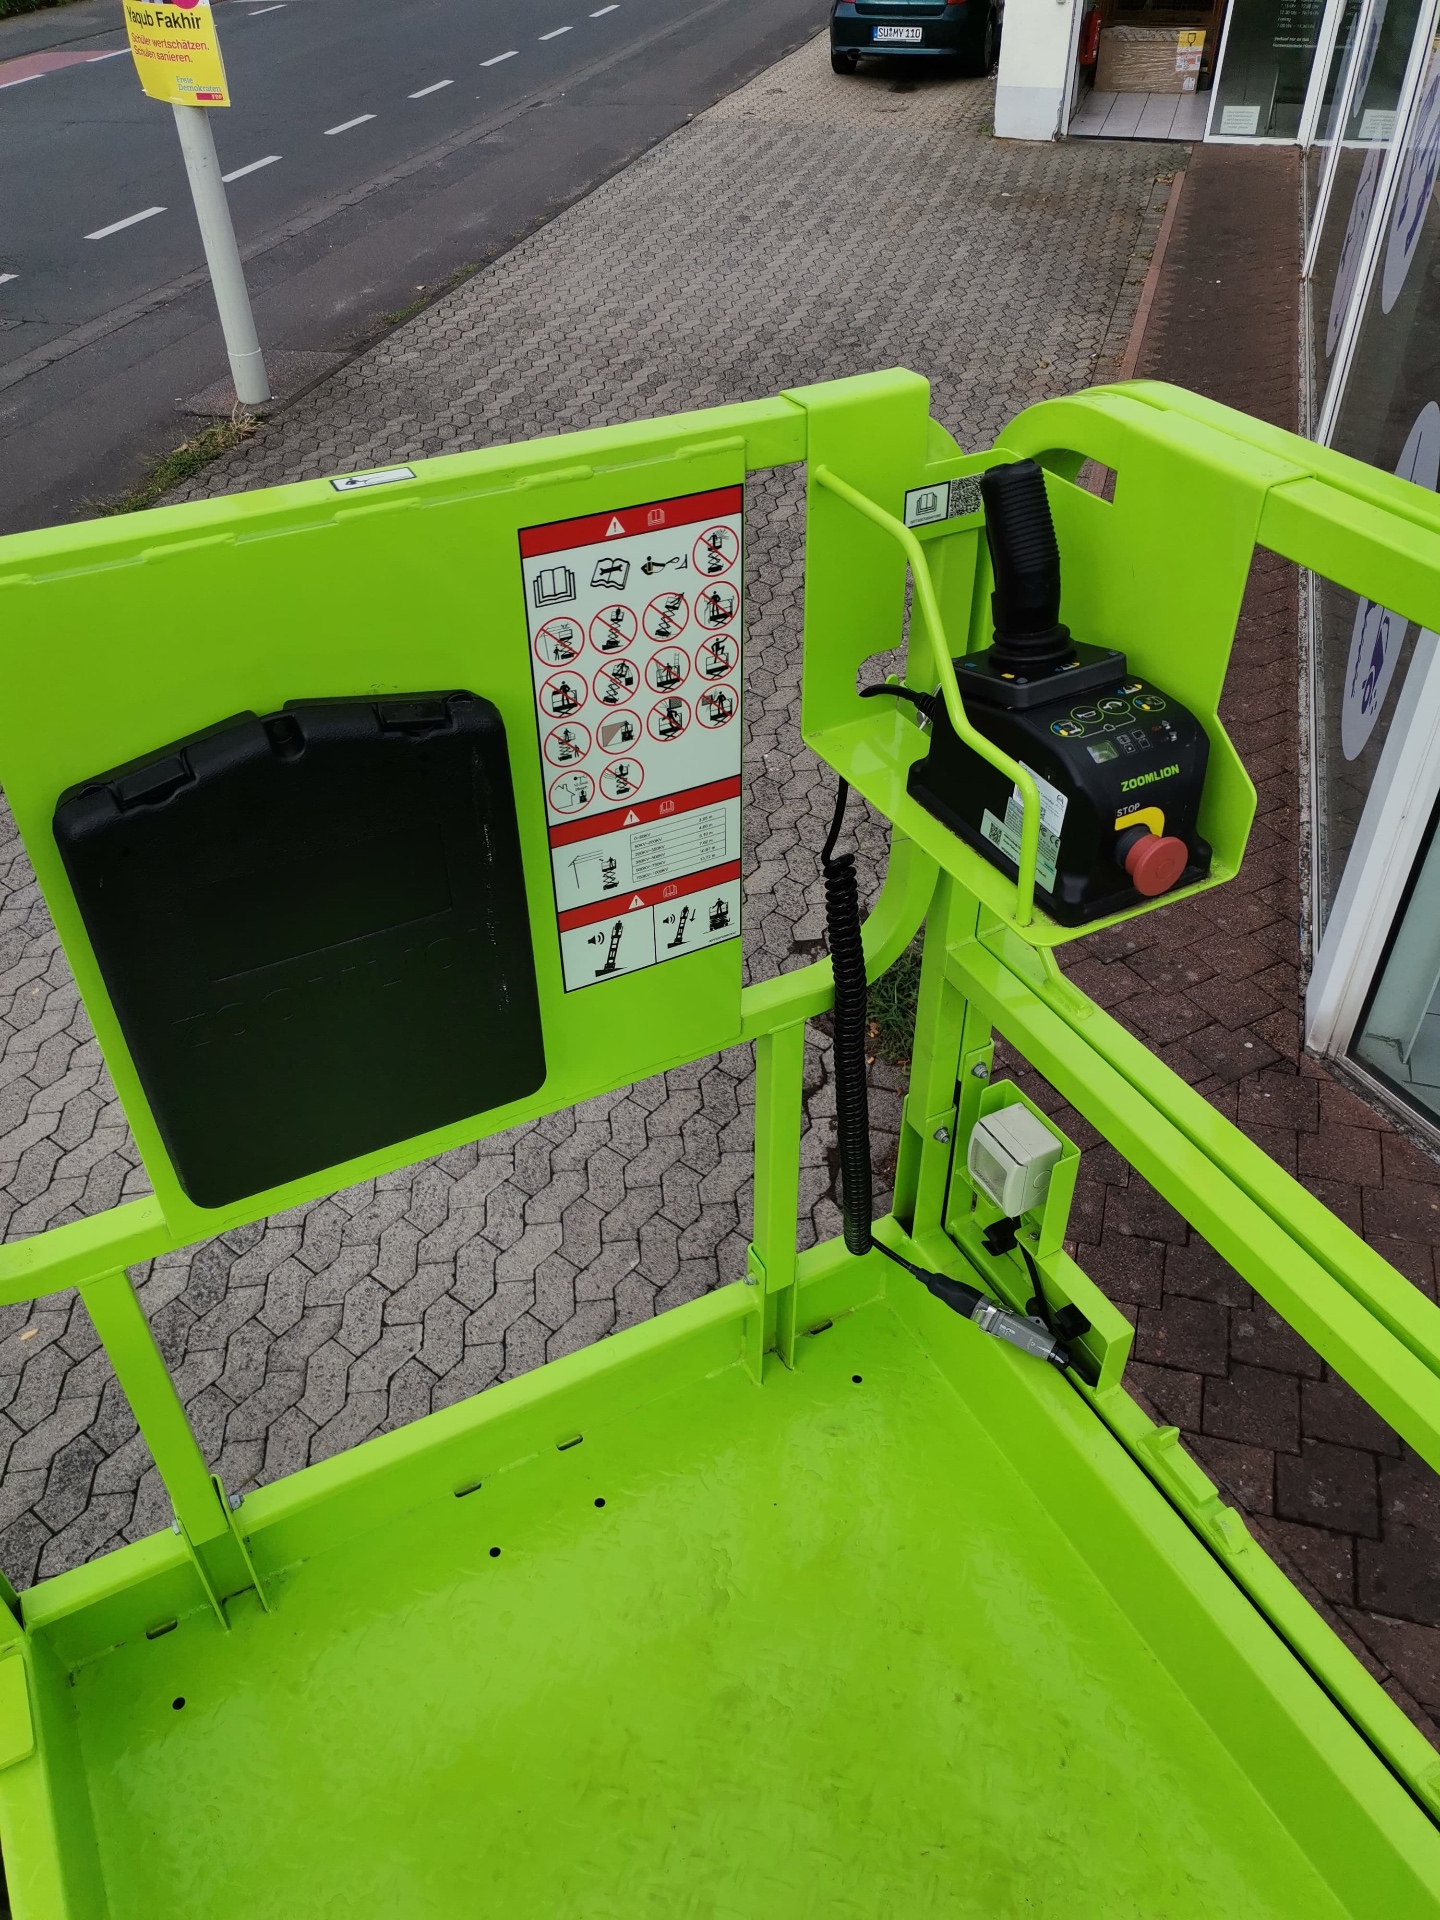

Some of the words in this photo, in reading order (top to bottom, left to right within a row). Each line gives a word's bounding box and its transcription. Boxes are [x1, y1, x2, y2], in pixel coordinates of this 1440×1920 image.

[127, 7, 154, 29] Yaqub
[156, 12, 201, 29] Fakhir
[878, 28, 889, 38] SU
[893, 28, 904, 38] MY
[905, 28, 920, 38] 110
[152, 38, 210, 51] wertschätzen.
[156, 51, 193, 63] sanieren.
[176, 76, 193, 84] Freie
[178, 84, 221, 93] Demokraten
[1121, 764, 1180, 792] ZOOMLION
[1117, 802, 1140, 817] STOP
